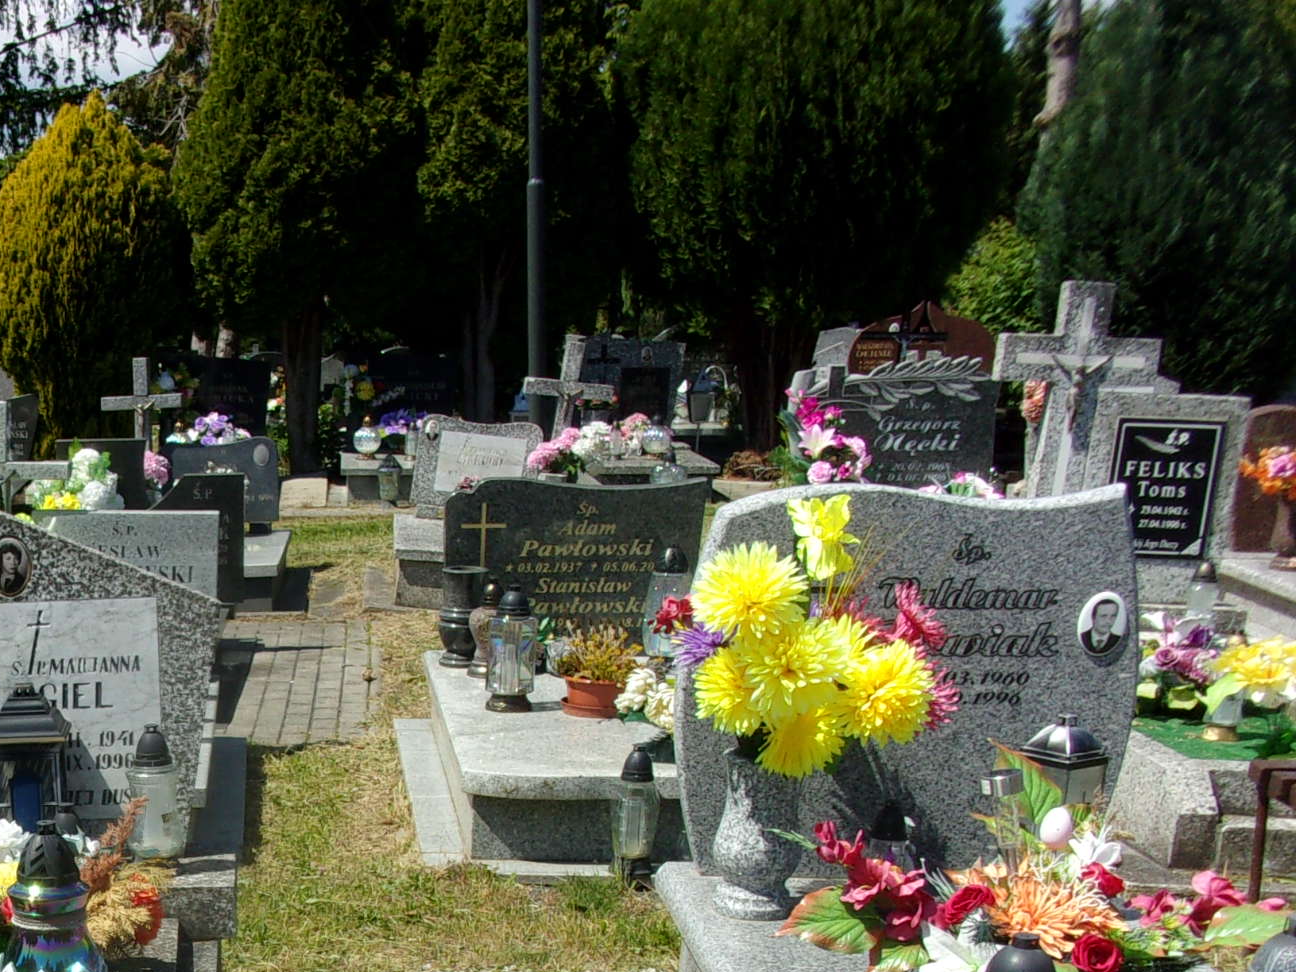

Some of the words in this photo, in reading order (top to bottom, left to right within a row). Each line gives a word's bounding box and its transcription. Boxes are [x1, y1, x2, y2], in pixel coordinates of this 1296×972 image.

[878, 415, 961, 433] Grzegorz
[1124, 460, 1206, 479] FELIKS
[1137, 481, 1187, 498] Toms
[559, 520, 617, 536] Adam
[519, 539, 654, 557] Pawłowski
[535, 577, 632, 595] Stanisław
